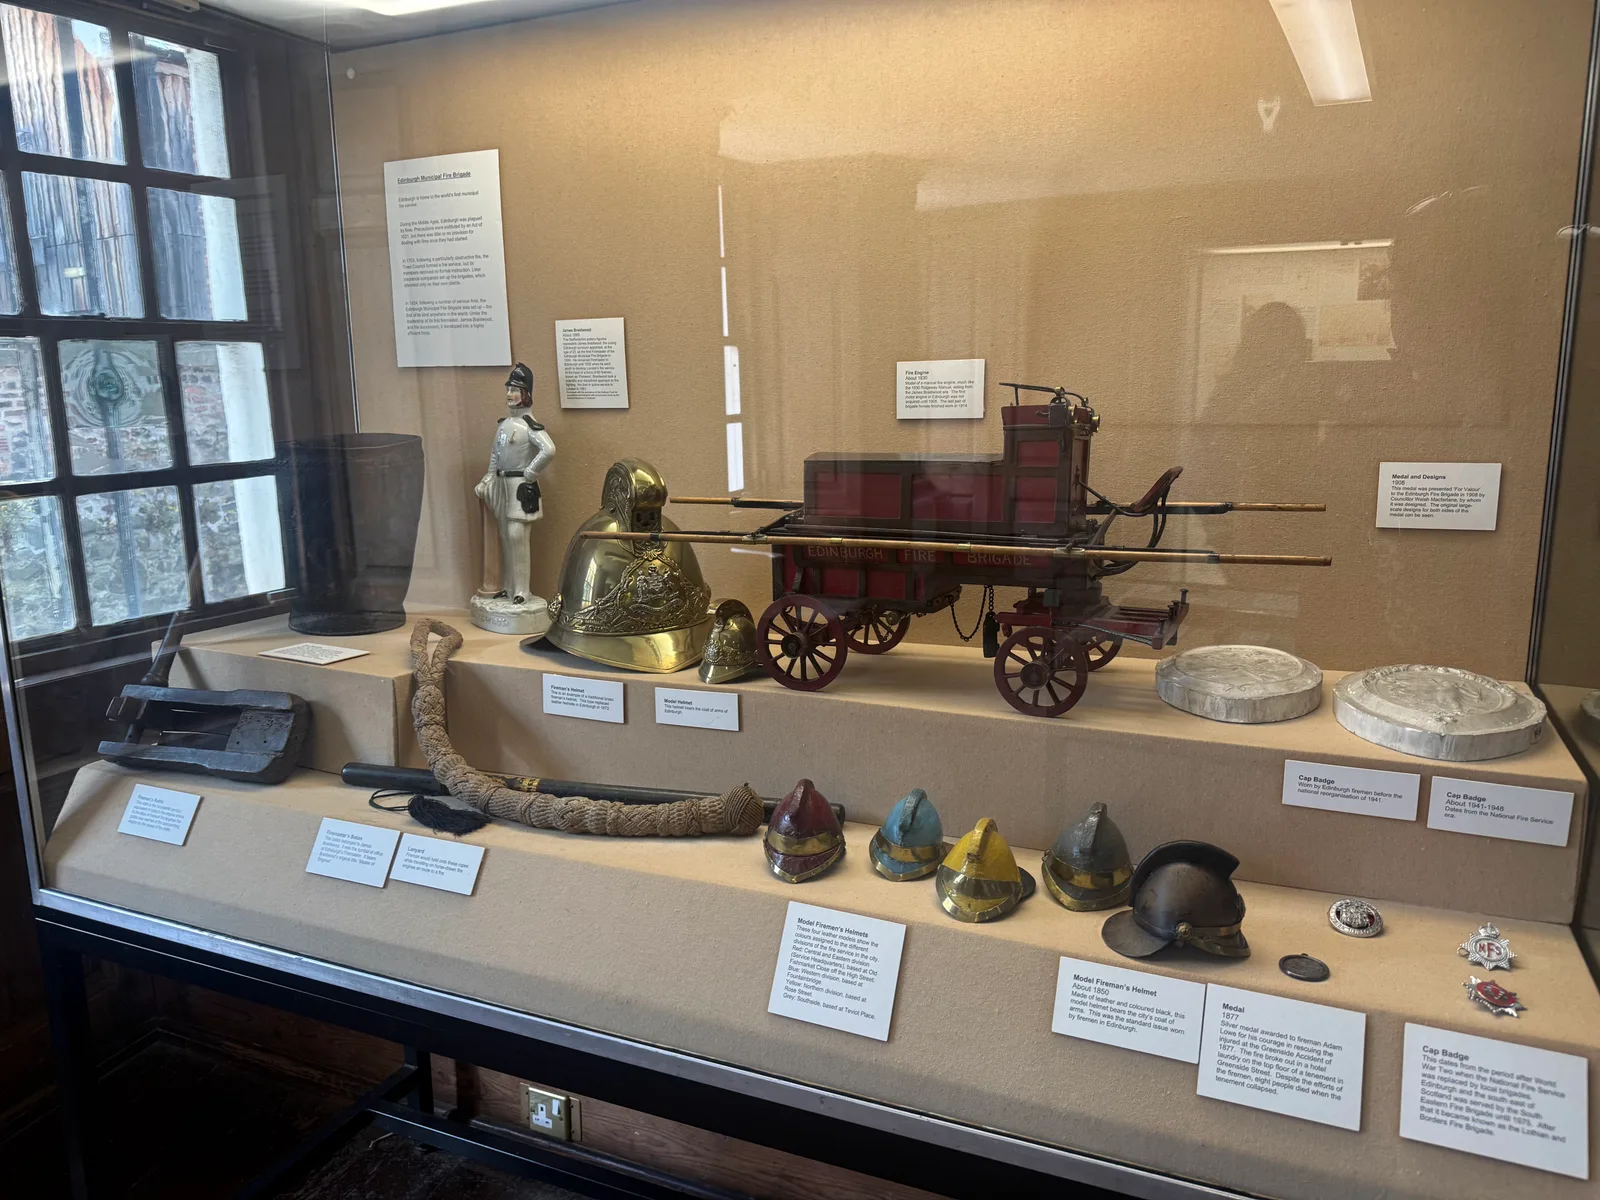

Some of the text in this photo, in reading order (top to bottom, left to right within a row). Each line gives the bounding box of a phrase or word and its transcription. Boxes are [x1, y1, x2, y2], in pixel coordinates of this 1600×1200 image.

[807, 546, 1032, 565] EDINBURGH FIRE BRIGADE
[1320, 792, 1360, 800] reorganisation
[1322, 785, 1350, 793] Edinburgh
[1462, 794, 1487, 802] Badge
[798, 918, 869, 938] Model Firemen's Helmets
[821, 930, 838, 939] leather
[1072, 983, 1110, 996] About 1850
[1073, 974, 1157, 996] Model Fireman's Helmet
[822, 1002, 838, 1010] based
[845, 1007, 860, 1016] Teviot
[860, 1011, 875, 1020] Place.
[1071, 991, 1088, 999] Made
[1095, 996, 1115, 1005] leather
[1129, 1004, 1155, 1013] coloured
[1155, 1008, 1173, 1018] black,
[1088, 1002, 1109, 1011] helmet
[1109, 1006, 1127, 1015] bears
[1222, 1003, 1245, 1013] Medal
[1077, 1014, 1099, 1024] firemen
[1106, 1021, 1137, 1033] Edinburgh.
[1126, 1018, 1152, 1028] standard
[1152, 1023, 1169, 1032] issue
[1223, 1012, 1238, 1020] 1877
[1220, 1028, 1237, 1037] Lowe
[1259, 1037, 1285, 1048] courage
[1294, 1045, 1322, 1056] rescuing
[1221, 1020, 1238, 1029] Silver
[1240, 1025, 1259, 1034] medal
[1260, 1030, 1288, 1040] awarded
[1297, 1036, 1322, 1047] fireman
[1323, 1042, 1343, 1051] Adam
[1219, 1036, 1241, 1046] injured
[1261, 1044, 1295, 1057] Greenside
[1296, 1052, 1324, 1064] Accident
[1219, 1044, 1237, 1053] 1877.
[1240, 1048, 1252, 1056] The
[1253, 1051, 1264, 1059] fire
[1265, 1053, 1284, 1063] broke
[1310, 1063, 1327, 1073] hotel
[1423, 1046, 1469, 1061] Cap Badge
[1217, 1059, 1250, 1072] Greenside
[1251, 1066, 1272, 1077] Street.
[1275, 1072, 1301, 1083] Despite
[1314, 1081, 1335, 1091] efforts
[1218, 1051, 1241, 1063] laundry
[1263, 1062, 1274, 1071] top
[1275, 1064, 1290, 1073] floor
[1305, 1071, 1336, 1083] tenement
[1215, 1075, 1278, 1095] tenement collapsed.
[1228, 1069, 1253, 1082] firemen,
[1255, 1076, 1271, 1085] eight
[1272, 1081, 1294, 1090] people
[1295, 1085, 1310, 1094] died
[1311, 1090, 1329, 1098] when
